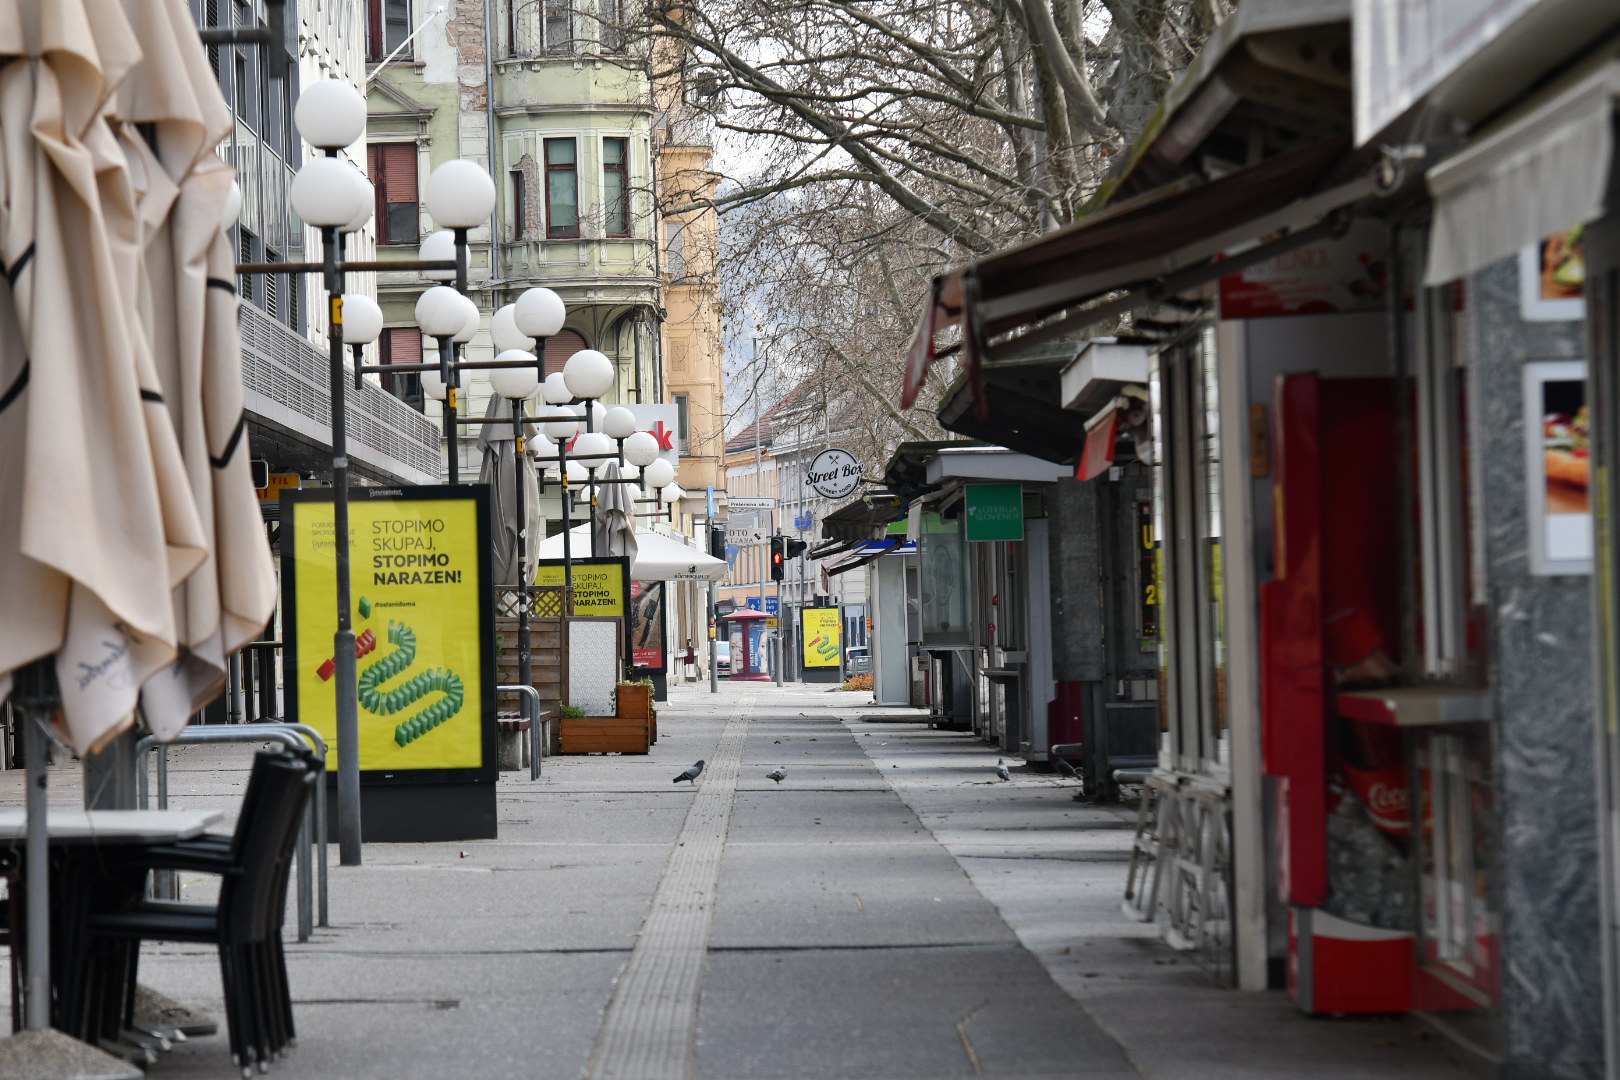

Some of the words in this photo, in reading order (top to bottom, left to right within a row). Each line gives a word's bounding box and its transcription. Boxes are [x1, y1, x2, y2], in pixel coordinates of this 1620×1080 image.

[805, 467, 839, 486] Street
[841, 463, 864, 478] Box
[820, 485, 838, 495] STREET
[838, 483, 852, 494] FOOD
[372, 519, 445, 535] STOPIMO
[372, 537, 436, 552] SKUPAJ,
[373, 553, 450, 569] STOPIMO
[373, 570, 462, 586] NARAZEN!
[572, 573, 608, 582] STOPIMO
[573, 590, 610, 599] STOPIMO
